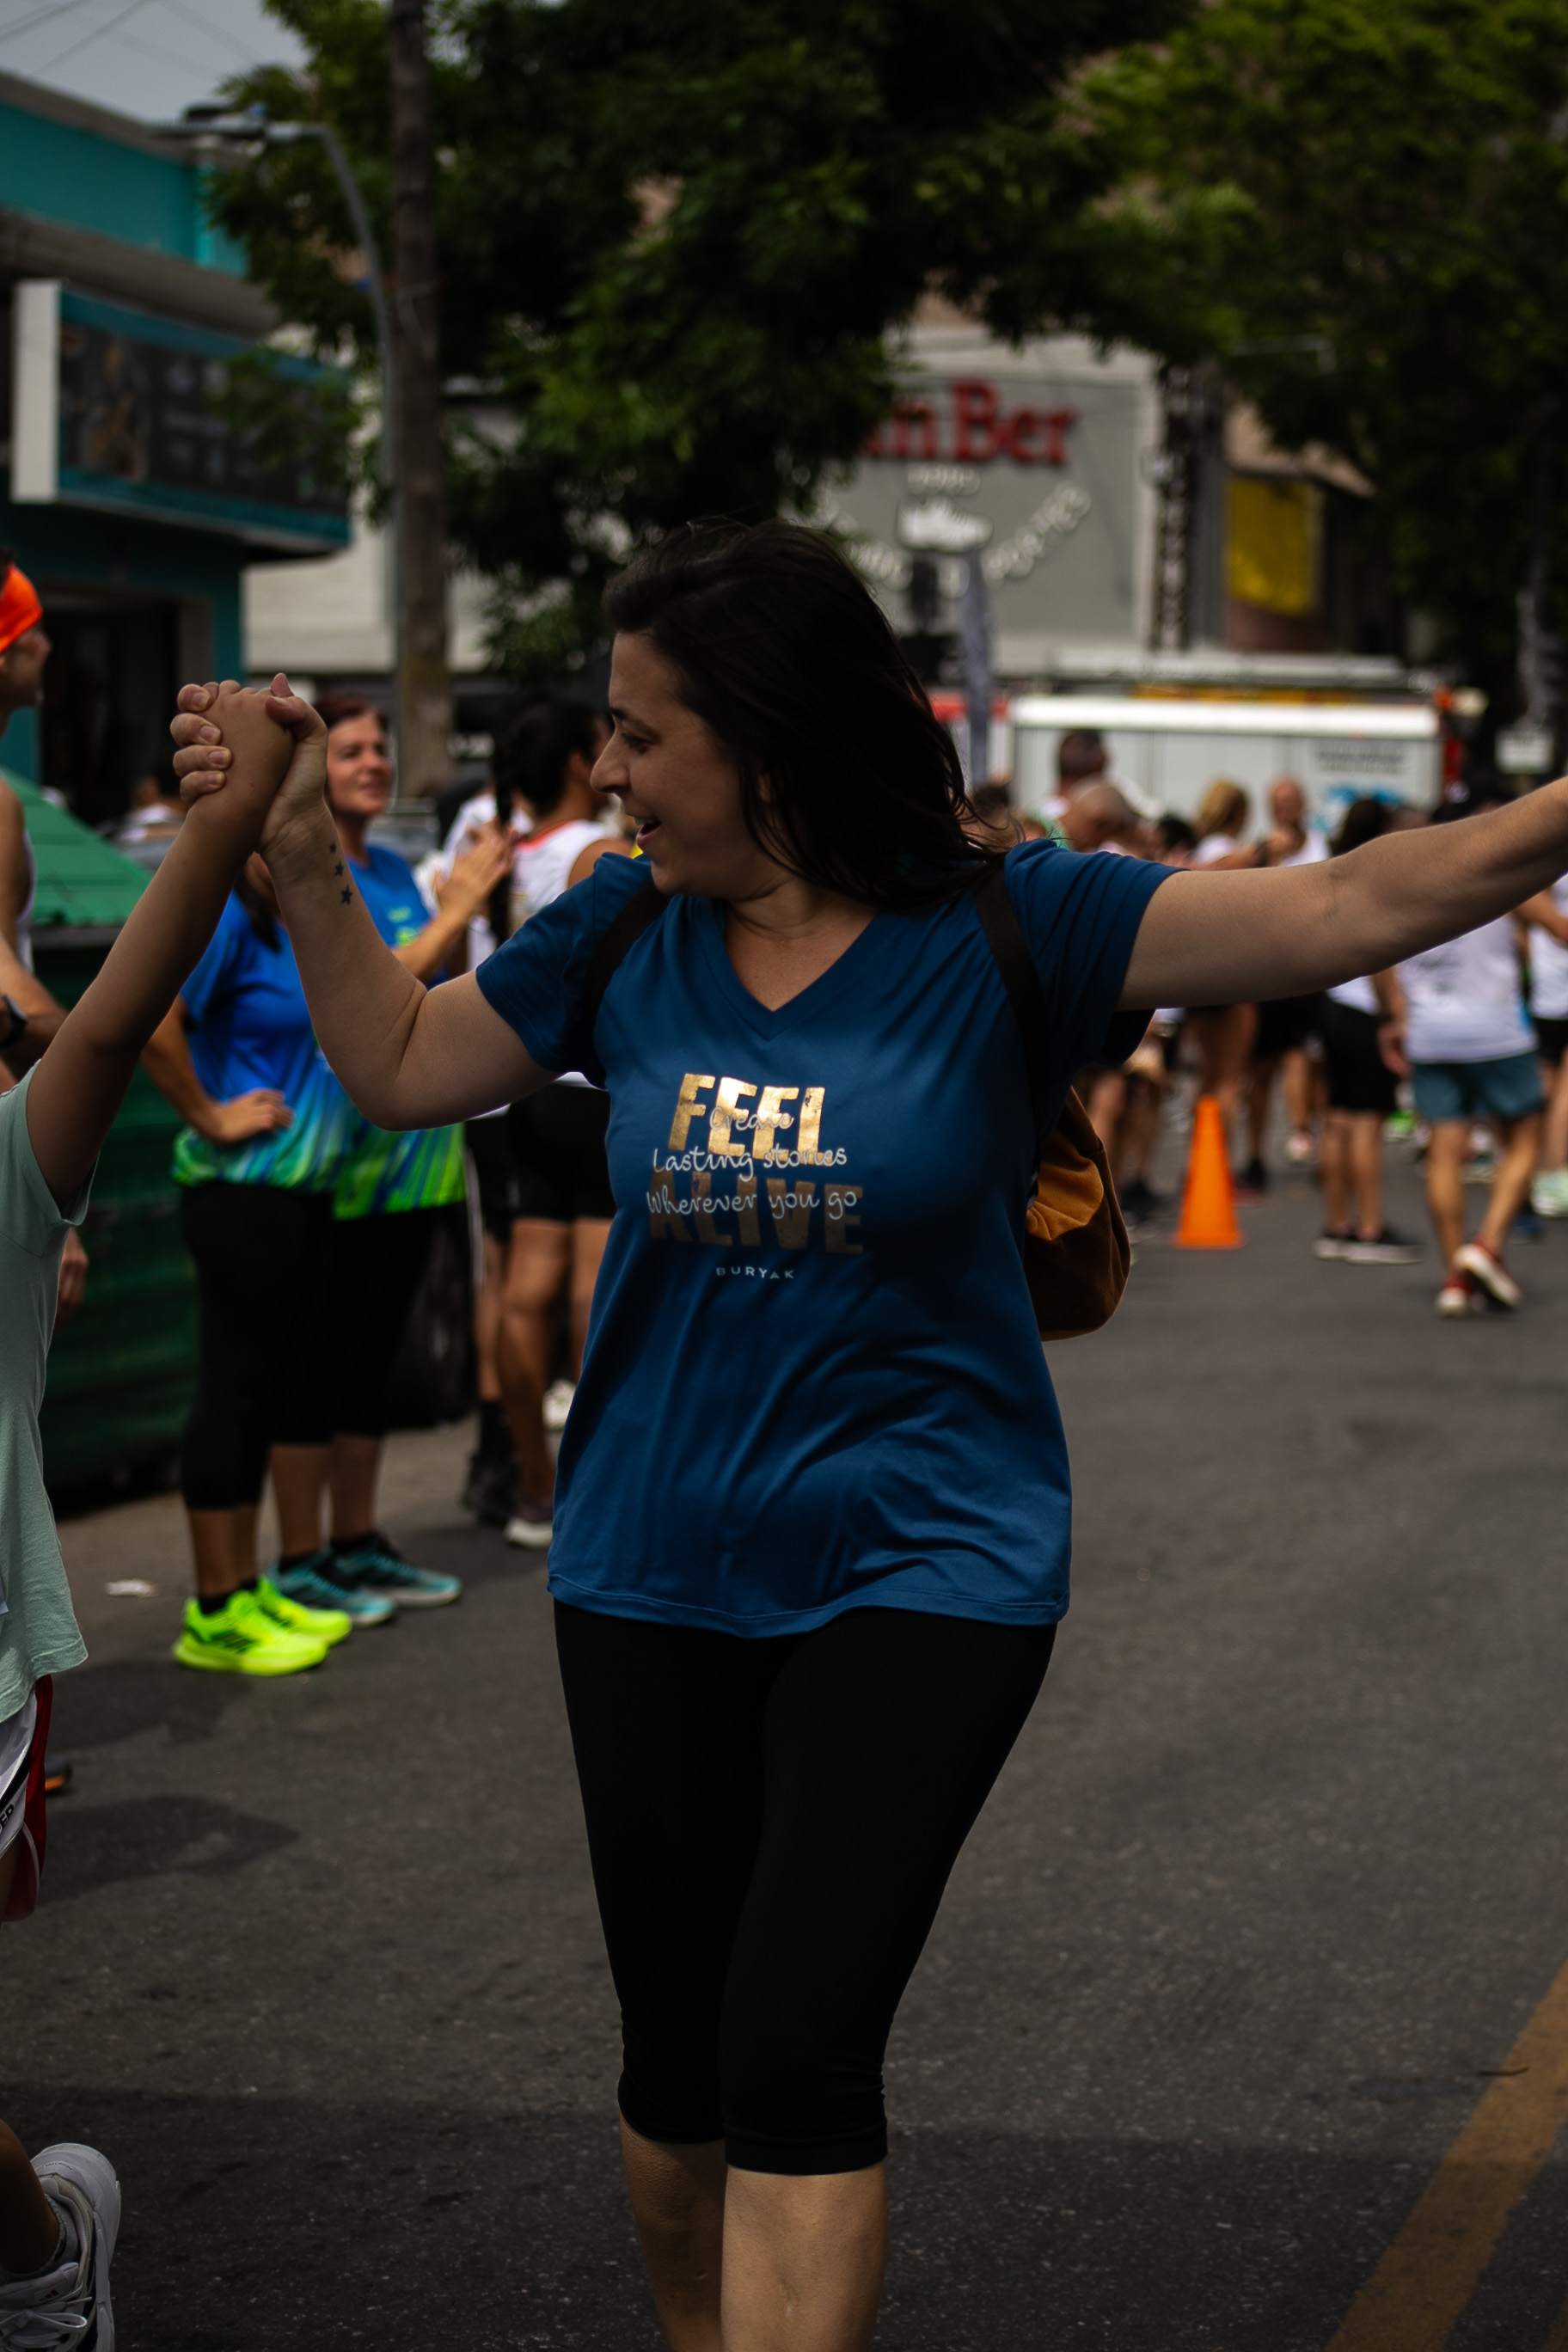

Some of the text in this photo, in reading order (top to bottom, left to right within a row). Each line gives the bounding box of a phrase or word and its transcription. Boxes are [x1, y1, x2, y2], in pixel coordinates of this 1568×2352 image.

[668, 1072, 832, 1167] FEEL
[652, 1142, 848, 1182] Lasting stories
[646, 1185, 858, 1221] Wherever you go
[649, 1166, 863, 1255] ALIVE
[715, 1265, 794, 1279] BURYAK
